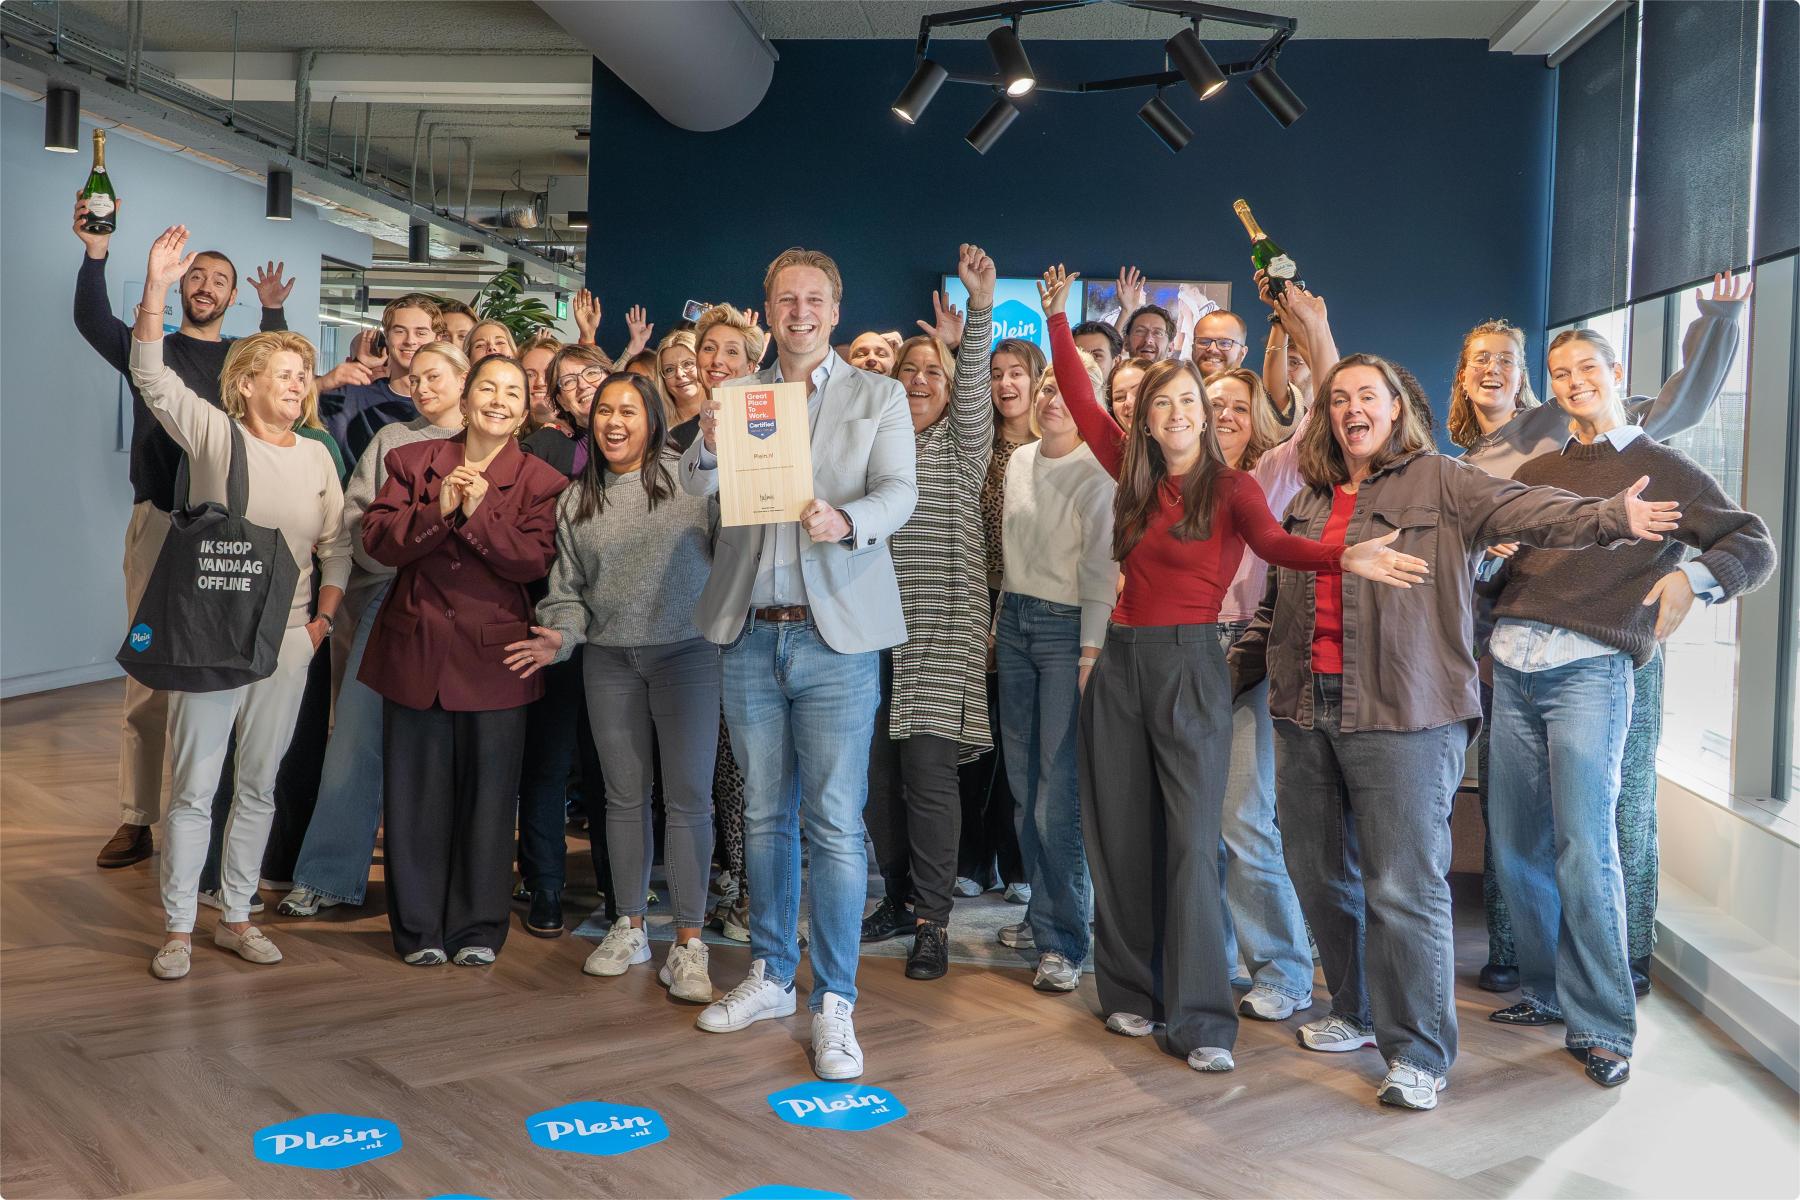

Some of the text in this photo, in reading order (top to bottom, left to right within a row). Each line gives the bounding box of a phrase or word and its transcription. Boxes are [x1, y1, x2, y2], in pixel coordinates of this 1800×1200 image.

[991, 319, 1037, 342] Plein
[749, 421, 775, 429] Certified
[200, 540, 252, 555] IK SHOP
[198, 557, 263, 575] VANDAAG
[197, 575, 251, 591] OFFLINE
[131, 632, 151, 643] Plein
[778, 1093, 887, 1118] Plein
[870, 1104, 892, 1115] .nl
[533, 1115, 653, 1141] Plein
[629, 1127, 652, 1138] .nl
[261, 1128, 388, 1155] Plein
[360, 1139, 384, 1151] .nl
